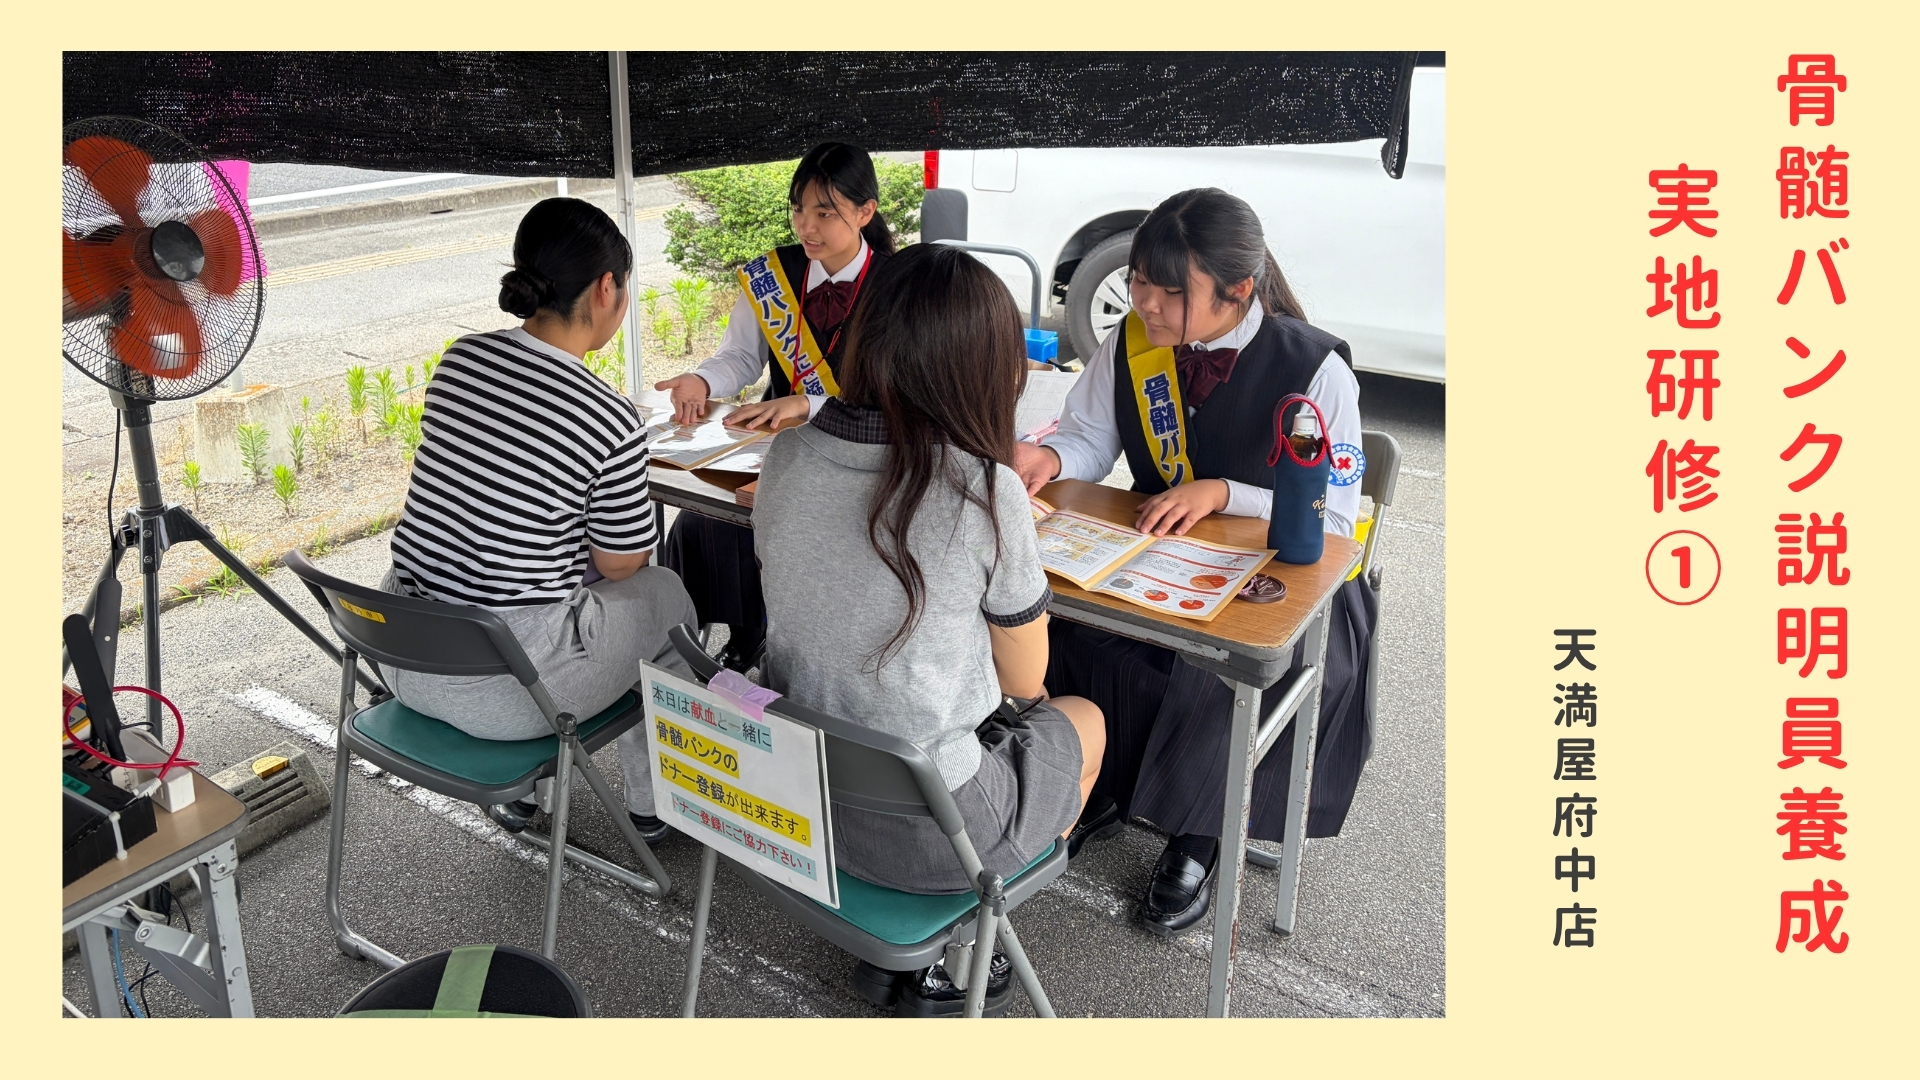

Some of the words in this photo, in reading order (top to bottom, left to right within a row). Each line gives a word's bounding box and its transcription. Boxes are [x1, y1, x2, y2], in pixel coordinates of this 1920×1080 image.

[1143, 372, 1184, 488] 骨髄バン
[652, 686, 772, 748] 本日は献血と一緒に
[656, 720, 738, 773] 骨髄バンクの
[659, 756, 807, 842] ドナー登録が出来ます。
